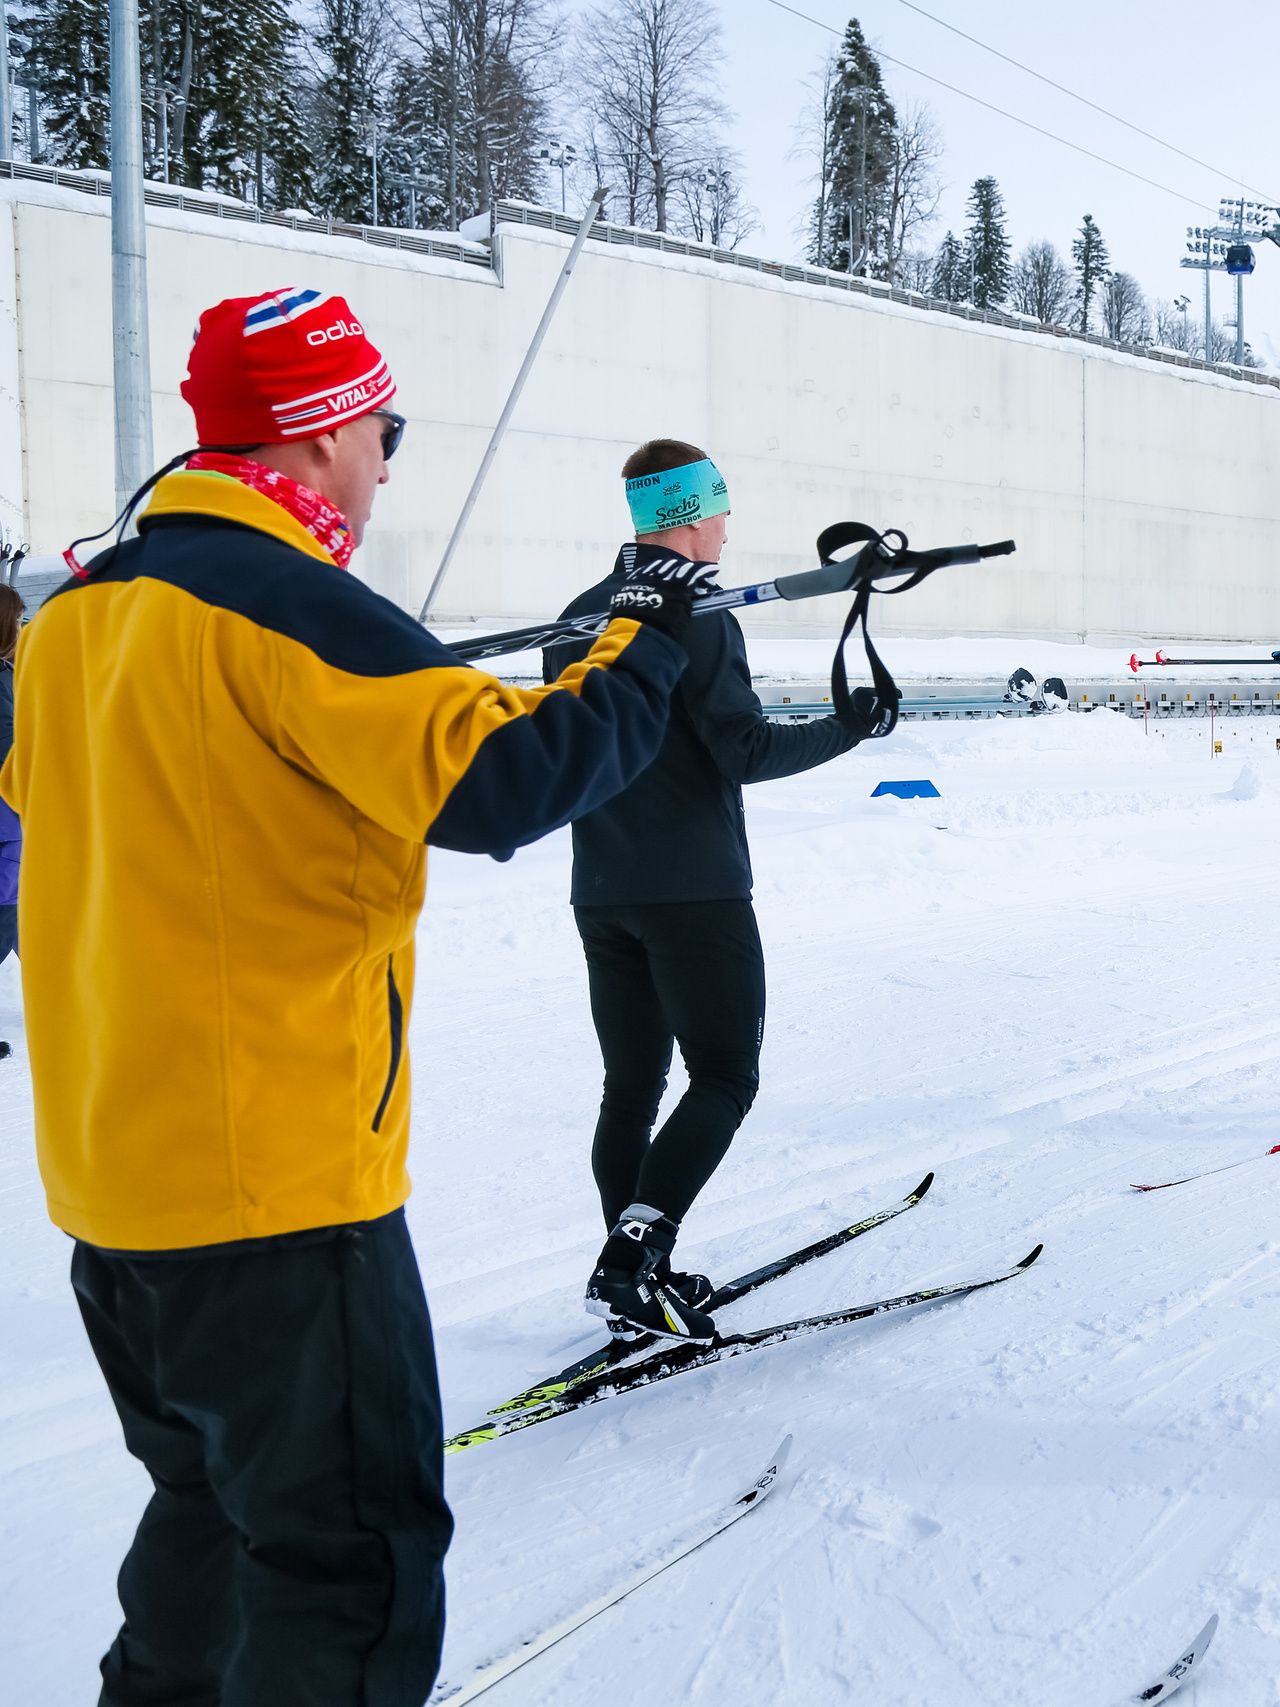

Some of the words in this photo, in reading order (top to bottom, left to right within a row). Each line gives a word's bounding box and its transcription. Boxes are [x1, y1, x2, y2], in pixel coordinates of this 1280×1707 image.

[306, 319, 364, 346] odlo
[655, 493, 701, 525] Sochi
[658, 512, 702, 530] MARATHON
[611, 591, 663, 609] OAKLE
[1166, 1663, 1188, 1681] 182
